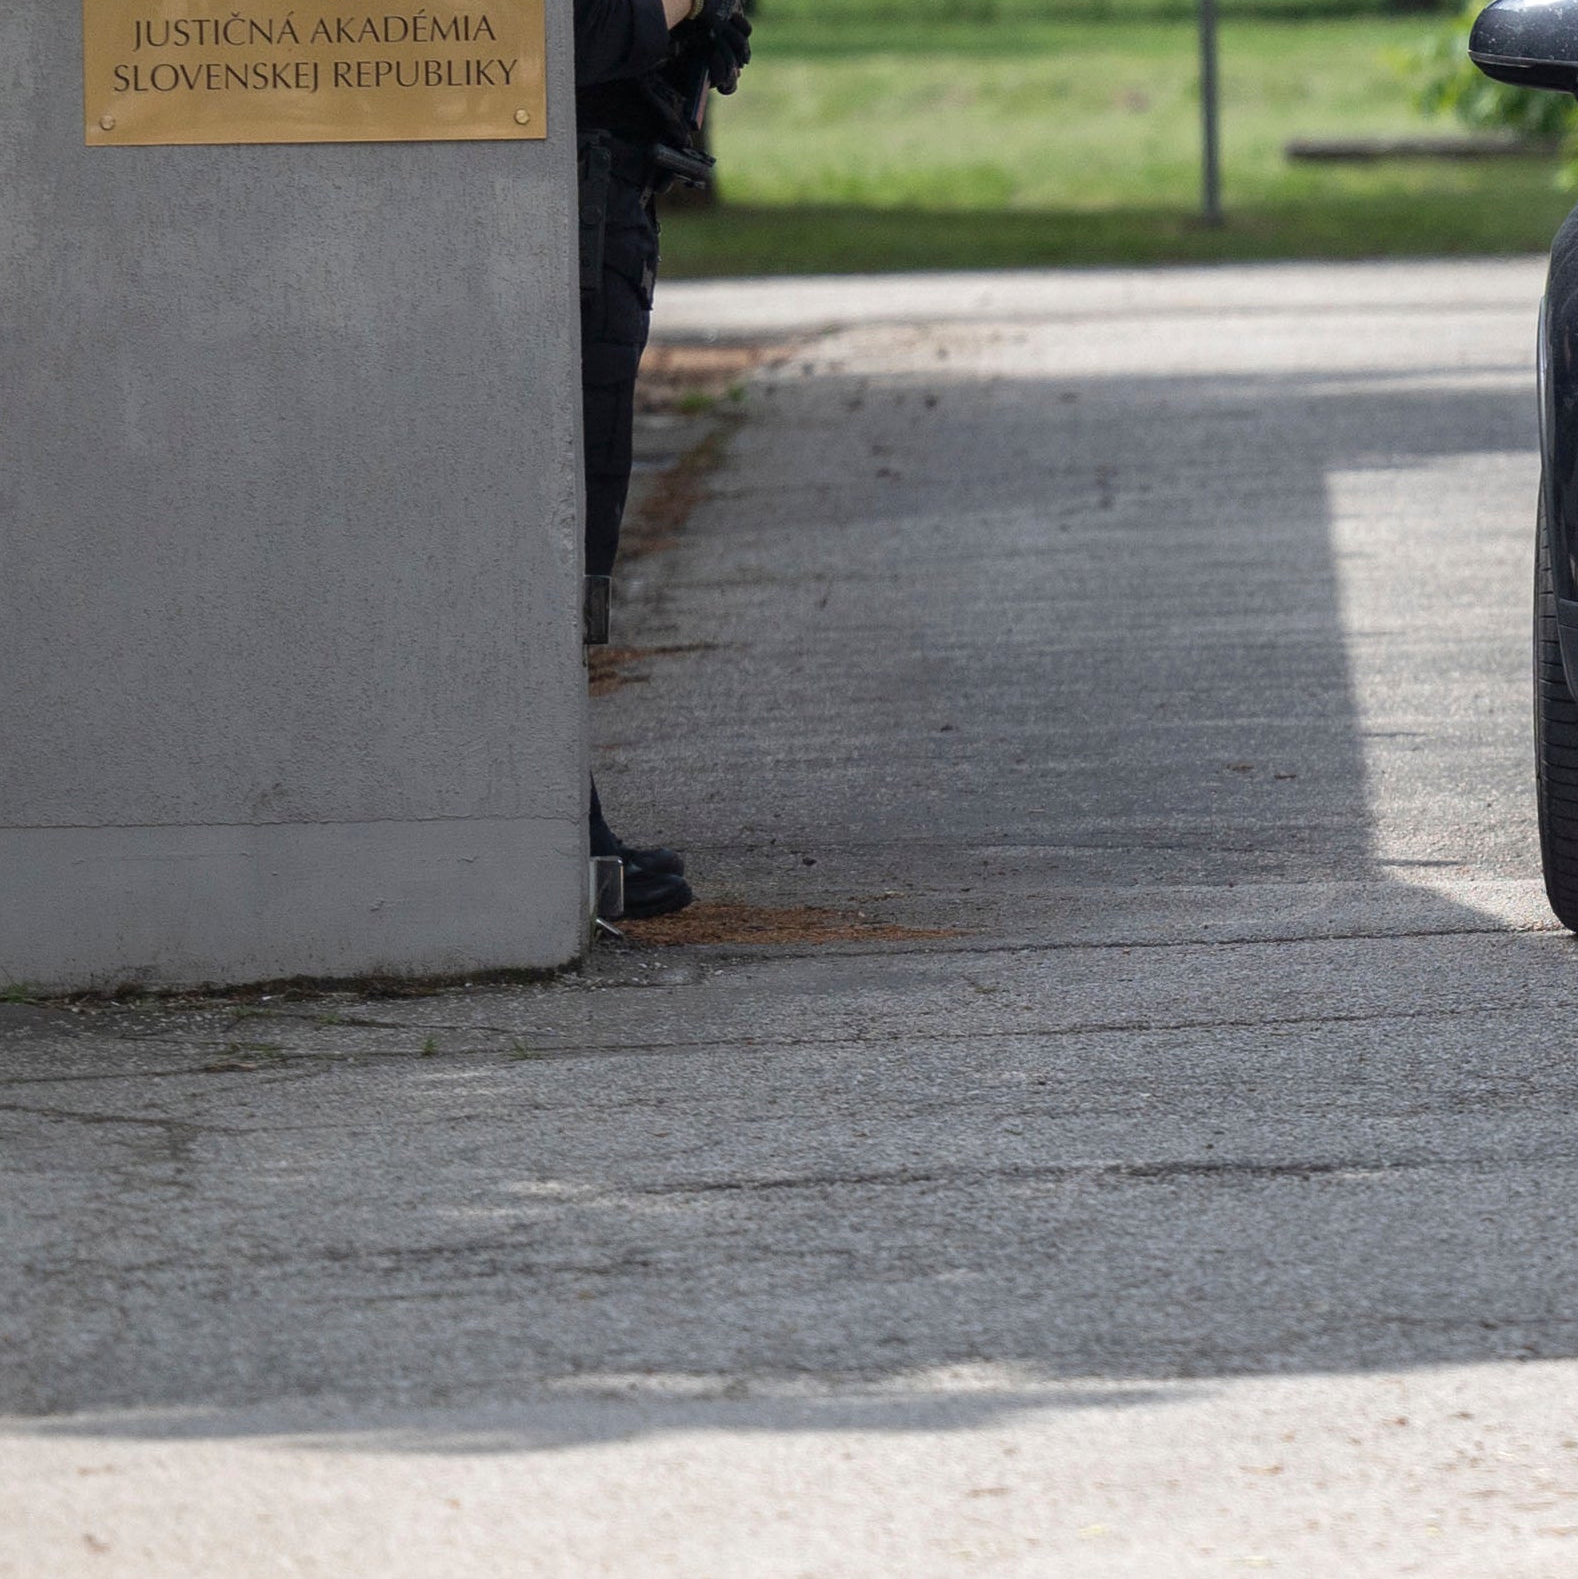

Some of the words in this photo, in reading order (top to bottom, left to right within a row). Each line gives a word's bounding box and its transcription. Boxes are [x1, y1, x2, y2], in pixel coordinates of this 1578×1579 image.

[133, 10, 300, 51] JUSTIČNÁ
[310, 8, 497, 44] AKADÉMIA
[113, 62, 319, 93] SLOVENSKEJ
[333, 59, 518, 88] REPUBLIKY
